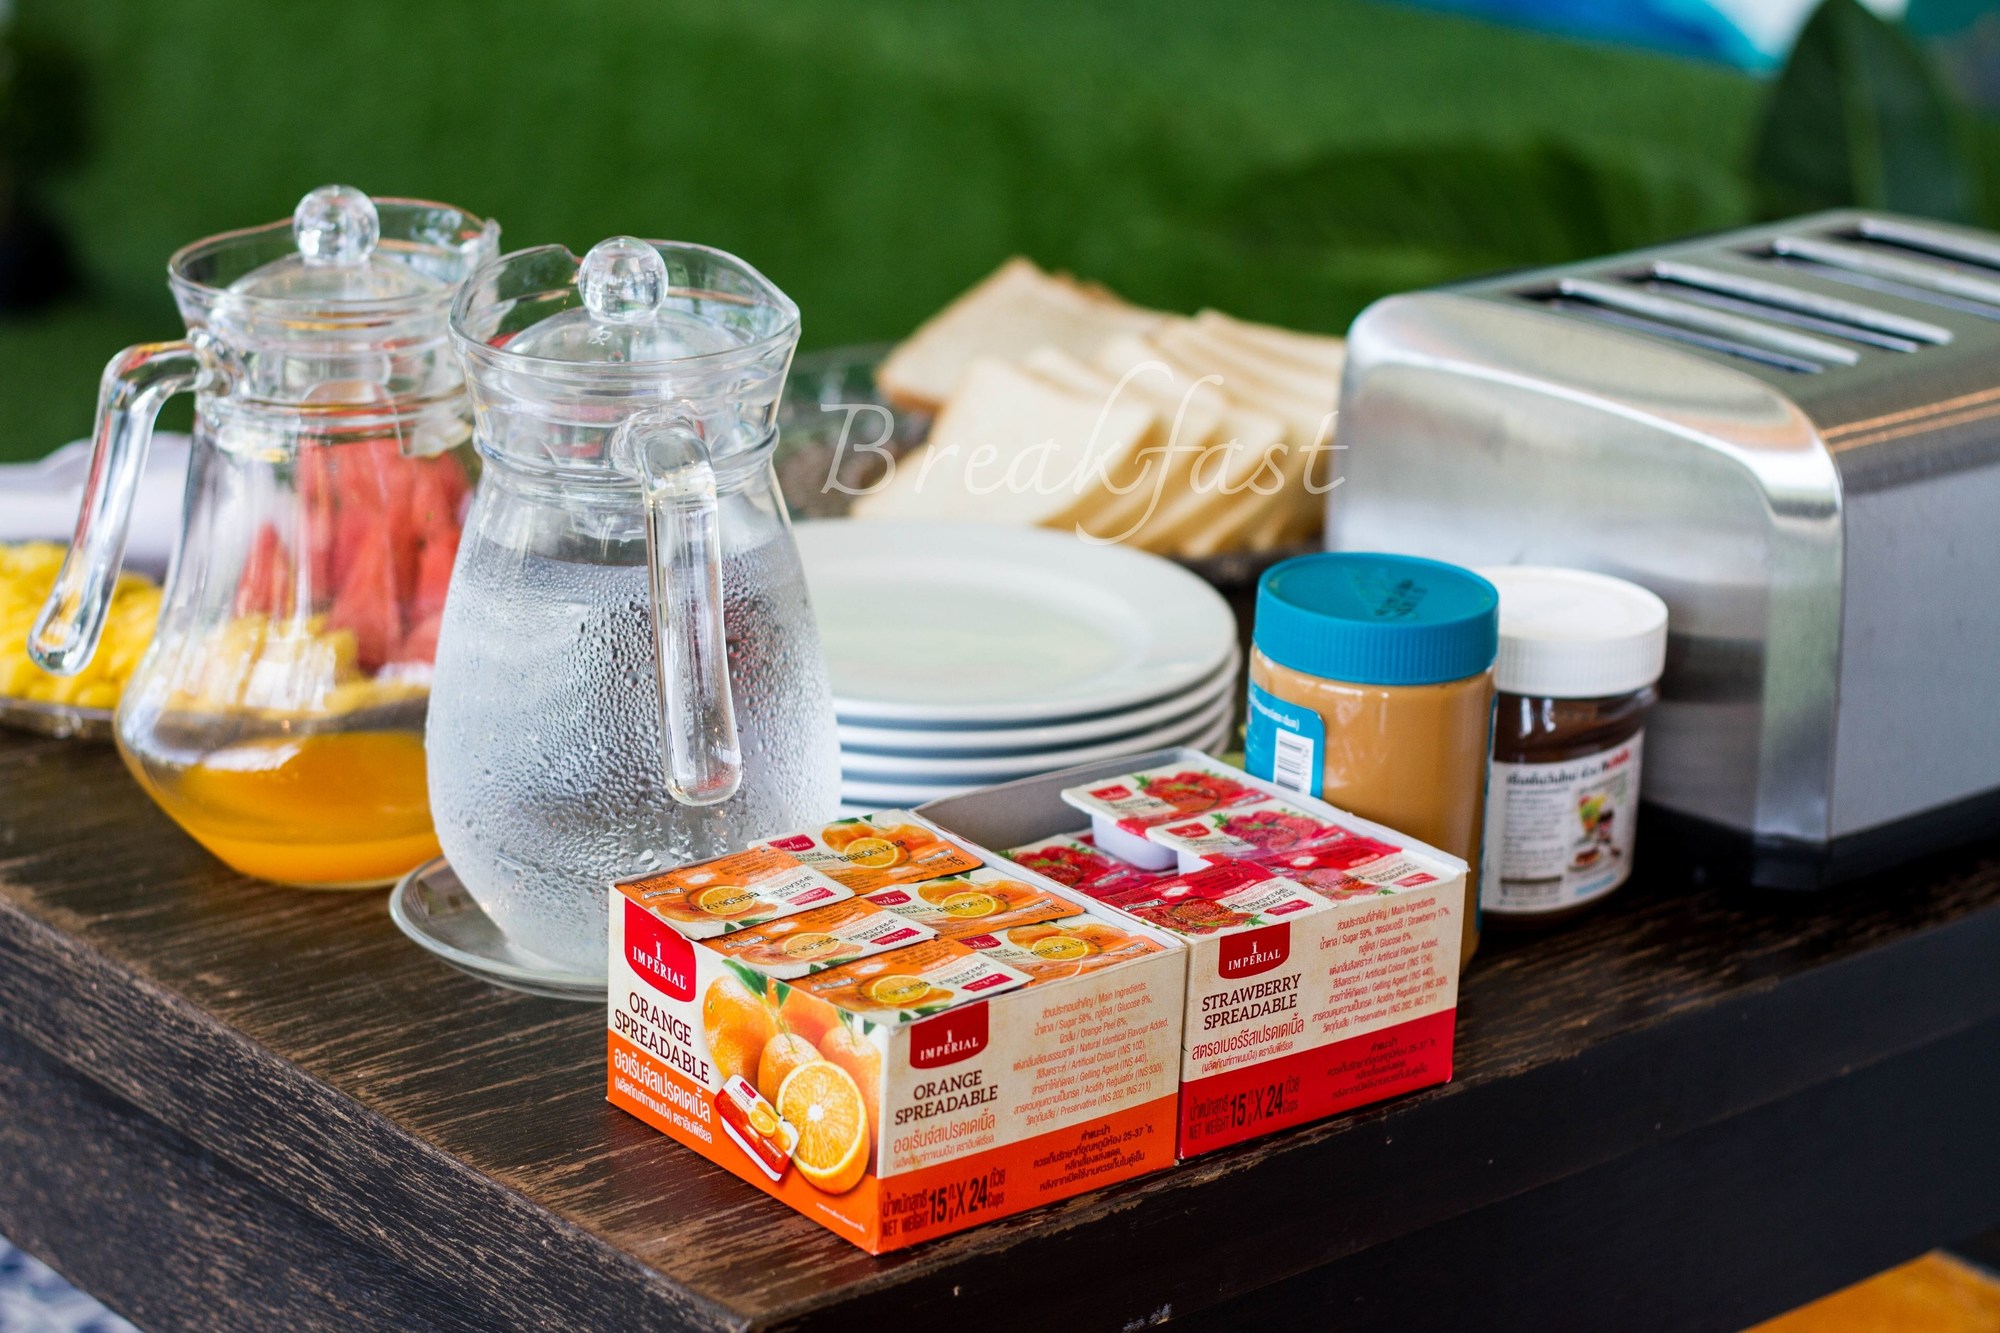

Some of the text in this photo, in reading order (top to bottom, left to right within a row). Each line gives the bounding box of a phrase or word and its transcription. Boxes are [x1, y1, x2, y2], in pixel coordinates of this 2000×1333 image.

[1391, 905, 1405, 915] Main
[1404, 897, 1435, 912] Ingredients
[1342, 933, 1358, 944] Sugar
[1408, 912, 1436, 926] Strawberry
[1380, 936, 1401, 947] Glucose
[1229, 949, 1280, 970] IMPERIAL
[1377, 949, 1399, 961] Artificial
[1400, 944, 1420, 955] Flavour
[633, 946, 687, 991] IMPERIAL
[1365, 966, 1387, 979] Artificial
[1388, 962, 1406, 973] Colour
[1372, 980, 1391, 991] Gelling
[1392, 975, 1408, 986] Agent
[1098, 992, 1112, 1003] Main
[1114, 982, 1146, 998] Ingredients
[1202, 974, 1300, 1011] STRAWBERRY
[1376, 993, 1394, 1003] Acidity
[1396, 985, 1421, 998] Regulator
[629, 991, 692, 1048] ORANGE
[1059, 1017, 1076, 1029] Sugar
[1117, 999, 1140, 1012] Glucose
[1204, 994, 1296, 1030] SPREADABLE
[1354, 1009, 1386, 1023] Preservative
[1080, 1025, 1102, 1038] Orange
[1103, 1019, 1115, 1031] Peel
[1080, 1039, 1100, 1052] Natural
[1102, 1031, 1126, 1045] Identical
[1127, 1025, 1148, 1037] Flavour
[1149, 1017, 1168, 1031] Added,
[614, 1008, 710, 1085] SPREADABLE
[921, 1037, 978, 1060] IMPERIAL
[1071, 1054, 1095, 1069] Artificial
[1097, 1050, 1116, 1061] Colour
[1118, 1043, 1130, 1057] (INS
[1079, 1069, 1100, 1081] Gelling
[1101, 1062, 1119, 1075] Agent
[1120, 1057, 1133, 1070] (INS
[1084, 1081, 1104, 1094] Acidity
[1106, 1071, 1133, 1087] Regulator
[1135, 1066, 1148, 1080] (INS
[914, 1070, 981, 1100] ORANGE
[1060, 1099, 1096, 1115] Preservative
[1098, 1092, 1111, 1105] (INS
[1126, 1084, 1137, 1095] INS
[1138, 1079, 1151, 1092] 211)
[895, 1085, 997, 1125] SPREADABLE
[1189, 1123, 1201, 1139] NET
[1205, 1114, 1230, 1134] WEIGHT
[1282, 1098, 1298, 1114] Cups
[1229, 1093, 1246, 1127] 15
[1253, 1088, 1264, 1120] X
[1266, 1083, 1283, 1117] 24
[1123, 1127, 1143, 1141] 25-37
[882, 1219, 897, 1236] NET
[900, 1211, 928, 1234] WEIGHT
[987, 1191, 1004, 1208] Cups
[928, 1188, 947, 1223] 15
[955, 1181, 966, 1216] X
[968, 1176, 987, 1212] 24
